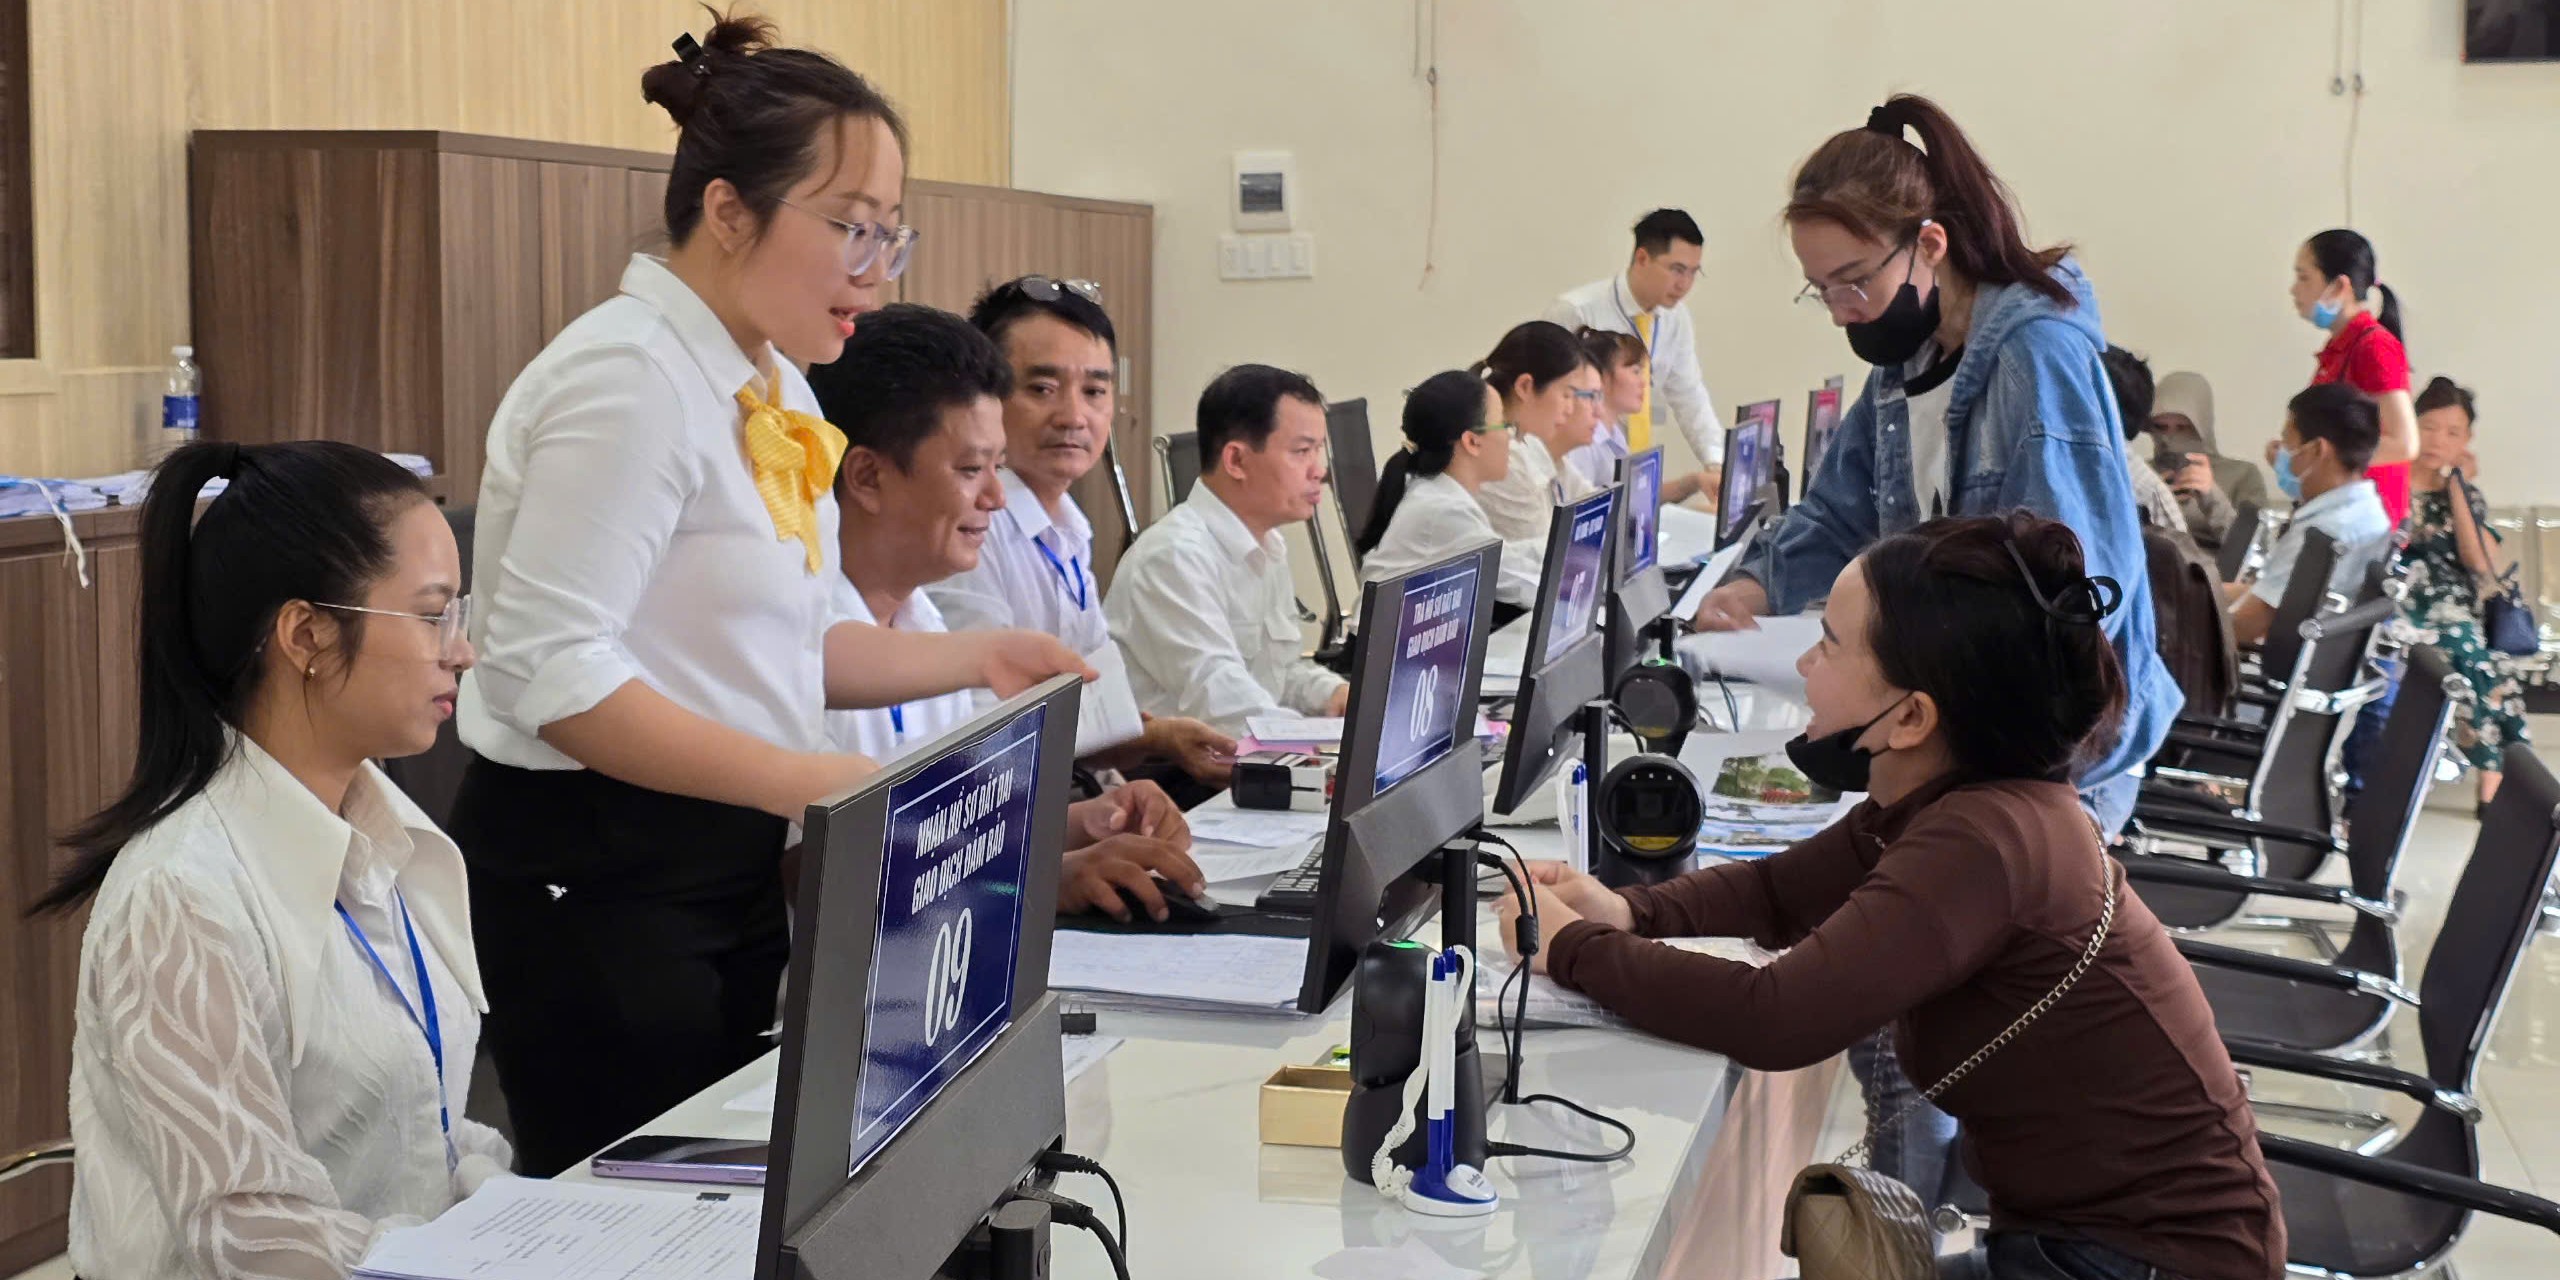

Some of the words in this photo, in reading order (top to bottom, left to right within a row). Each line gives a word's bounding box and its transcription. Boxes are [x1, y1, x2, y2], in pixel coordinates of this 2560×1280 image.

[1410, 664, 1438, 742] 08
[912, 865, 938, 915] GIAO
[938, 847, 964, 900] DỊCH
[962, 826, 987, 879] ĐẢM
[986, 812, 1006, 863] BẢO
[915, 804, 948, 859] NHẬN
[963, 784, 980, 829] SƠ
[924, 906, 973, 1047] 09
